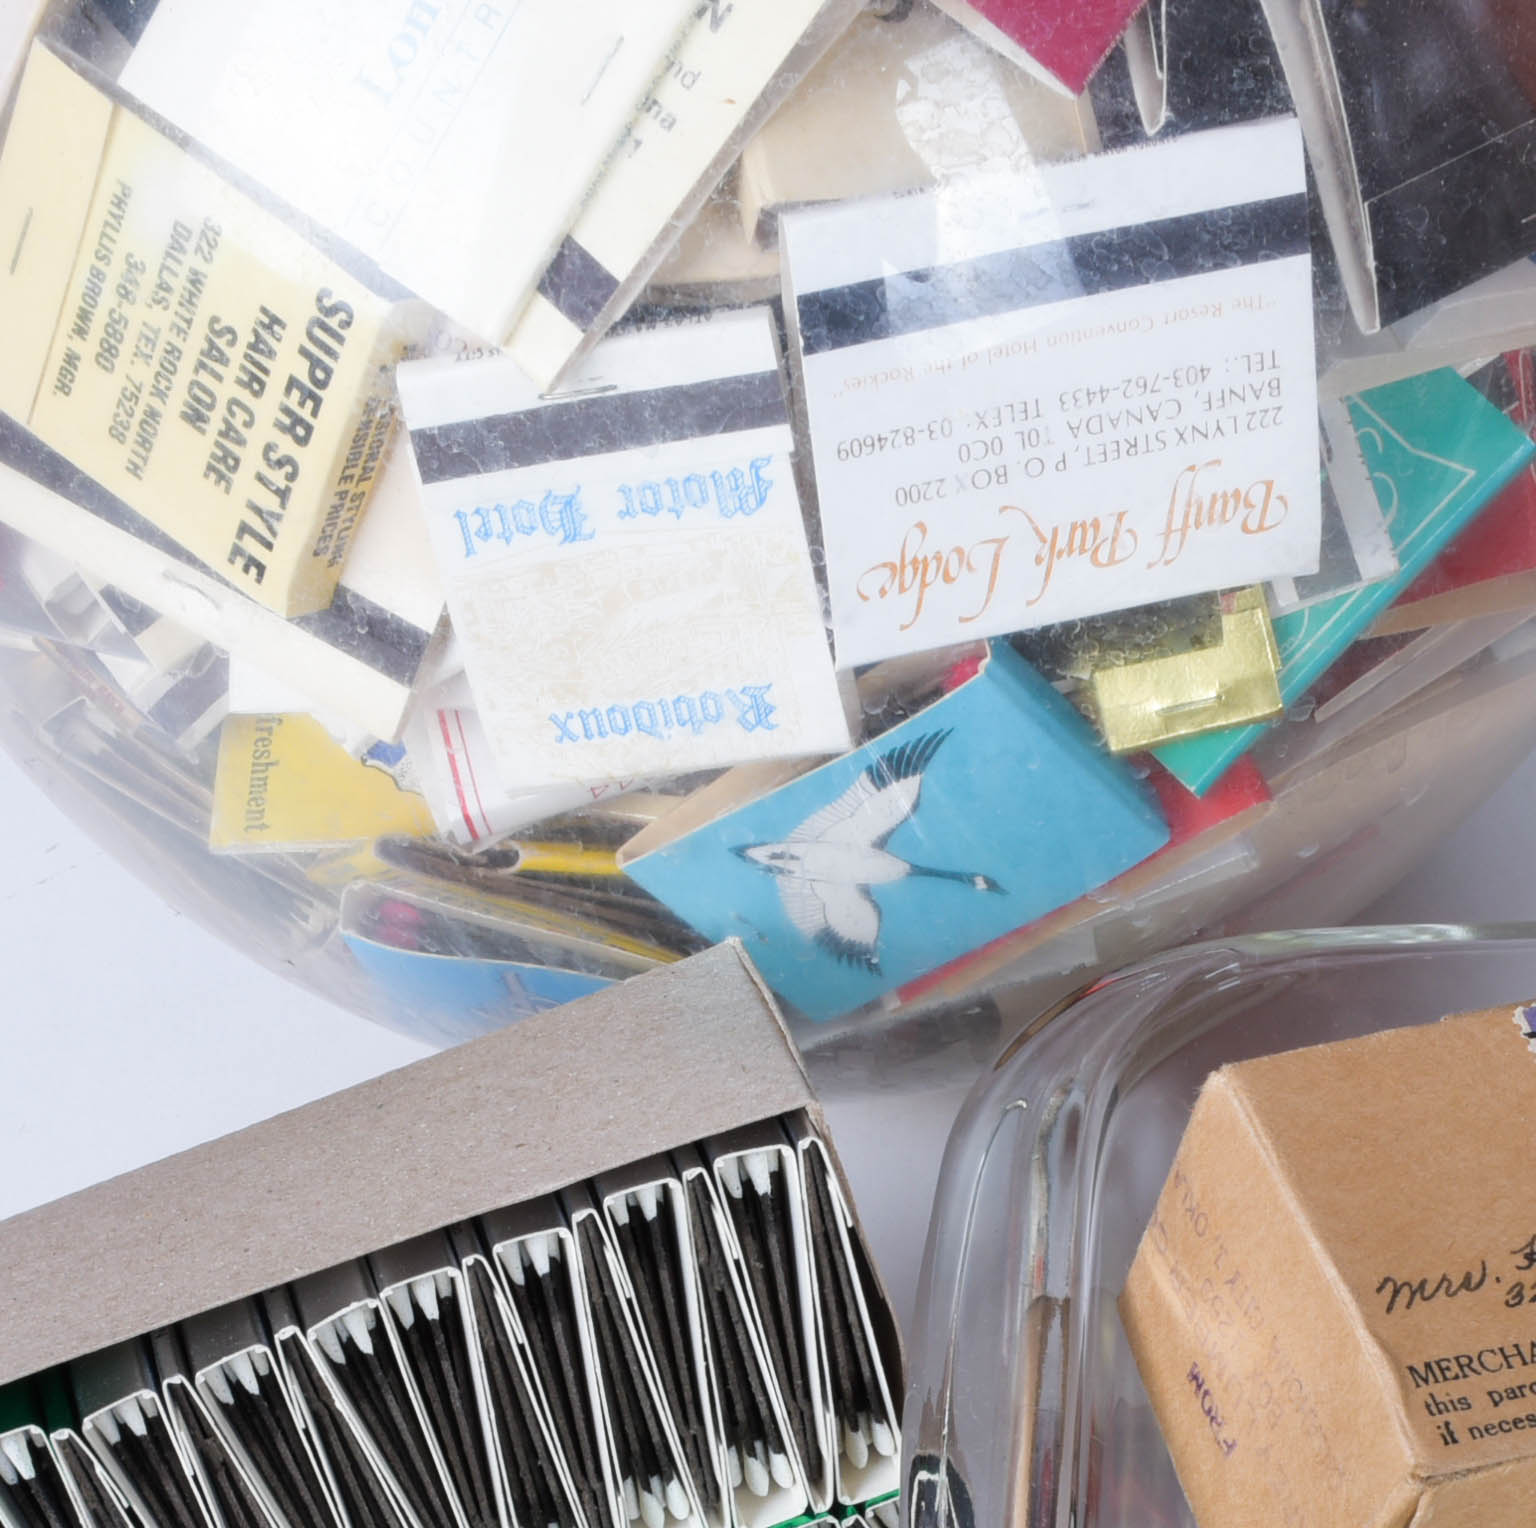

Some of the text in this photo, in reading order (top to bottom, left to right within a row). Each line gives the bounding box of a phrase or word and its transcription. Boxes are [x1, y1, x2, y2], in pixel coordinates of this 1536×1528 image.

[90, 180, 136, 266] PHYLLIS
[143, 217, 197, 311] DALLAS,
[120, 265, 211, 481] WHITE ROCK NORTH
[173, 312, 244, 439] SALON
[198, 302, 292, 498] HAIR CARE
[1066, 376, 1281, 439] BANFF, CANADA
[228, 306, 352, 585] SUPER STYLE
[1174, 415, 1238, 446] LYNX
[453, 455, 774, 558] Motor Hotel
[856, 459, 1289, 632] Banff Park Lodge
[548, 681, 780, 745] Robidoux
[1424, 1394, 1472, 1417] this
